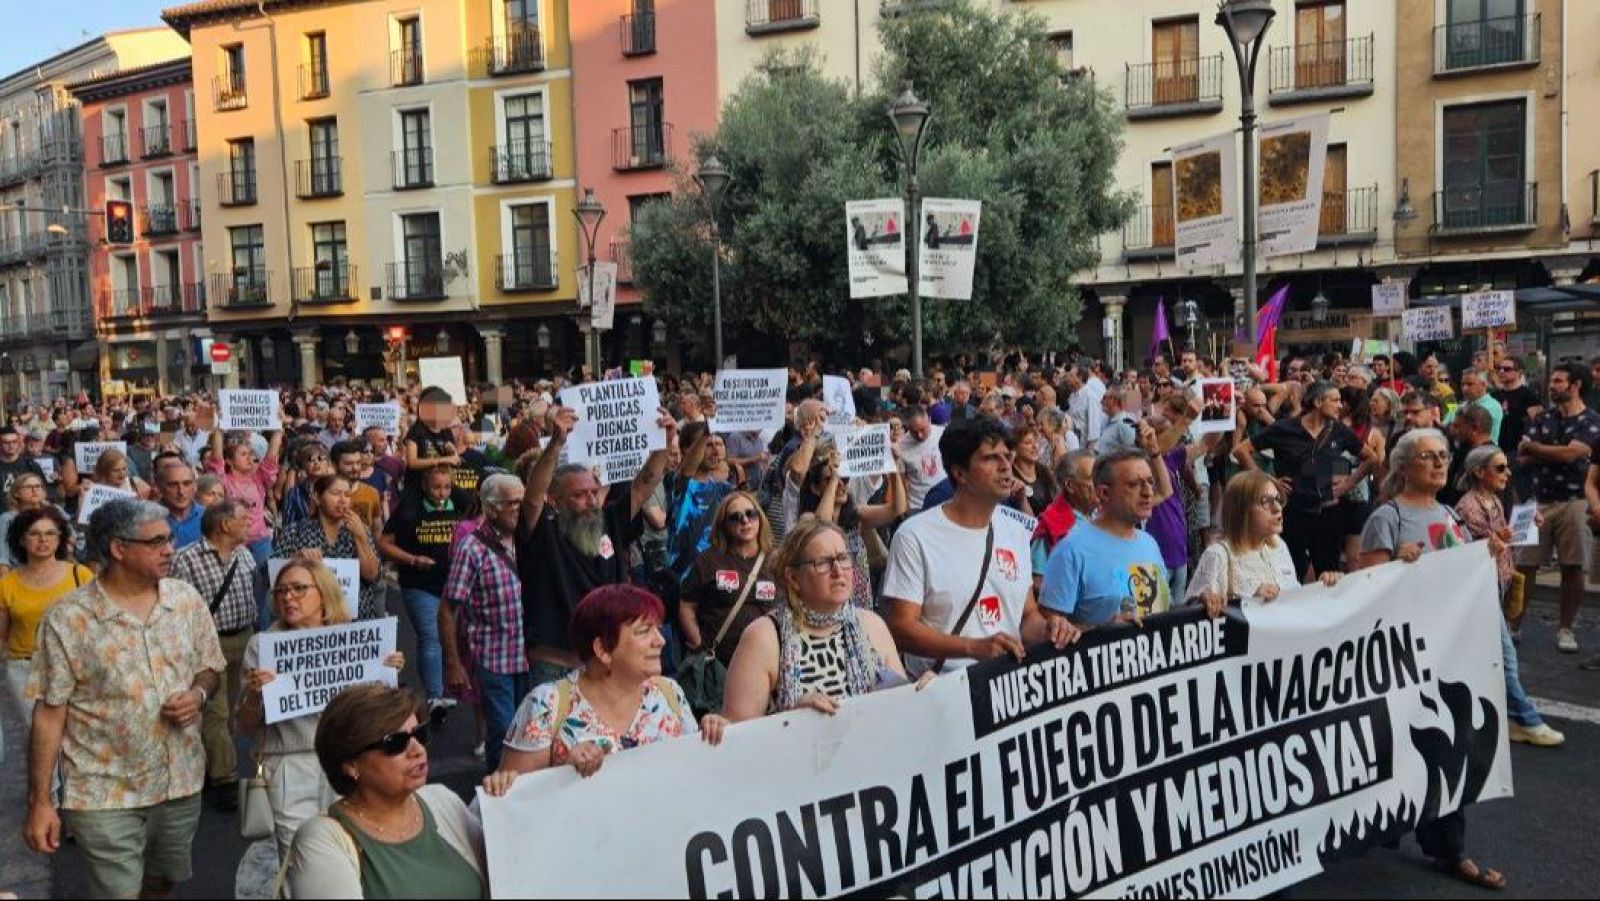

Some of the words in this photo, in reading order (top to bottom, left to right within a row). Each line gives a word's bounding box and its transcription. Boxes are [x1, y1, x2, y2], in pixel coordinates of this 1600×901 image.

[579, 381, 645, 403] PLANTILLAS
[597, 418, 637, 438] DIGNAS
[586, 441, 593, 457] Y
[595, 433, 648, 457] ESTABLES
[274, 630, 347, 657] INVERSIÓN
[350, 627, 382, 645] REAL
[276, 658, 293, 674] EN
[296, 643, 379, 669] PREVENCIÓN
[988, 651, 1088, 724] NUESTRA
[1088, 631, 1168, 687] TIERRA
[1168, 617, 1226, 667] ARDE
[293, 674, 302, 690] Y
[304, 664, 364, 687] CUIDADO
[279, 693, 303, 714] DEL
[685, 773, 939, 899] CONTRA
[945, 752, 995, 847] EL
[998, 702, 1124, 823] FUEGO
[1131, 683, 1183, 768] DE
[1187, 671, 1237, 750] LA
[1241, 618, 1432, 732] INACCIÓN:
[1130, 782, 1157, 863] Y
[1164, 734, 1314, 852] MEDIOS
[1310, 715, 1378, 796] YA!
[1200, 828, 1302, 899] DIMISIÓN!
